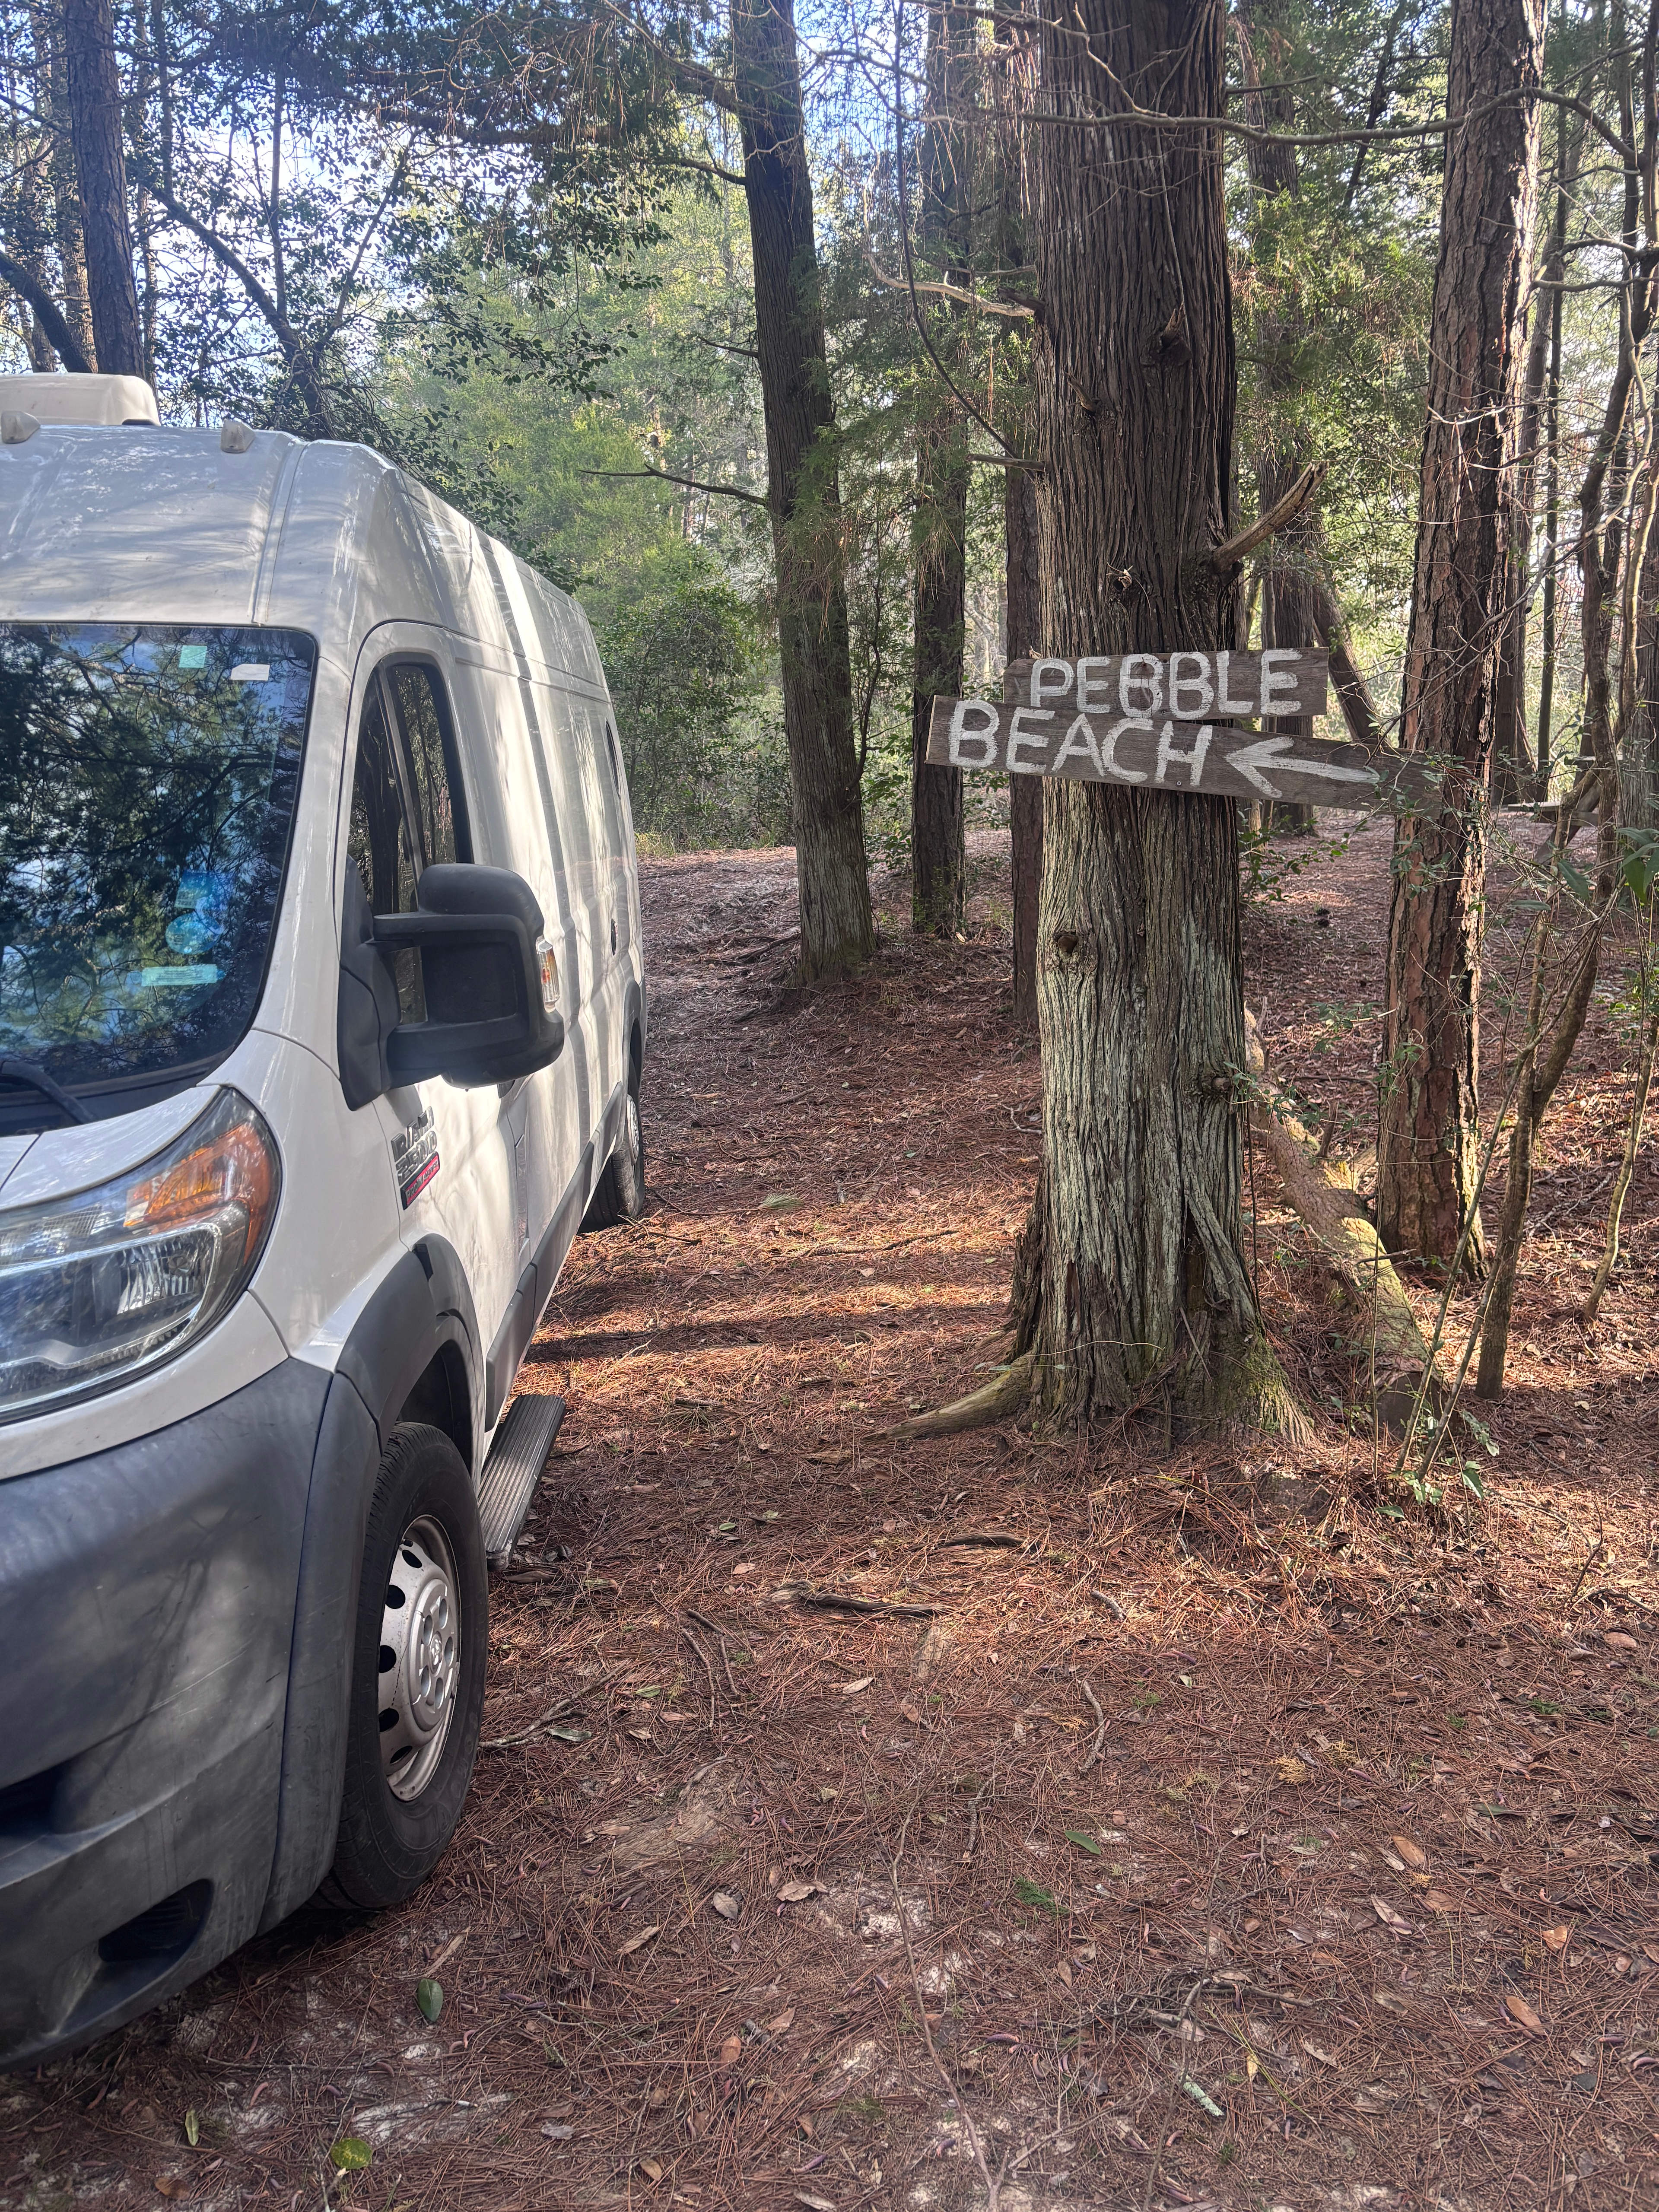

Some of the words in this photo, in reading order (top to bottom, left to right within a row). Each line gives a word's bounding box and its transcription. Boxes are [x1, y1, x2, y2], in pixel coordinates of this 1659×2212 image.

[1030, 649, 1303, 719] PEBBLE
[949, 699, 1213, 786] BEACH
[395, 1130, 437, 1186] 2500
